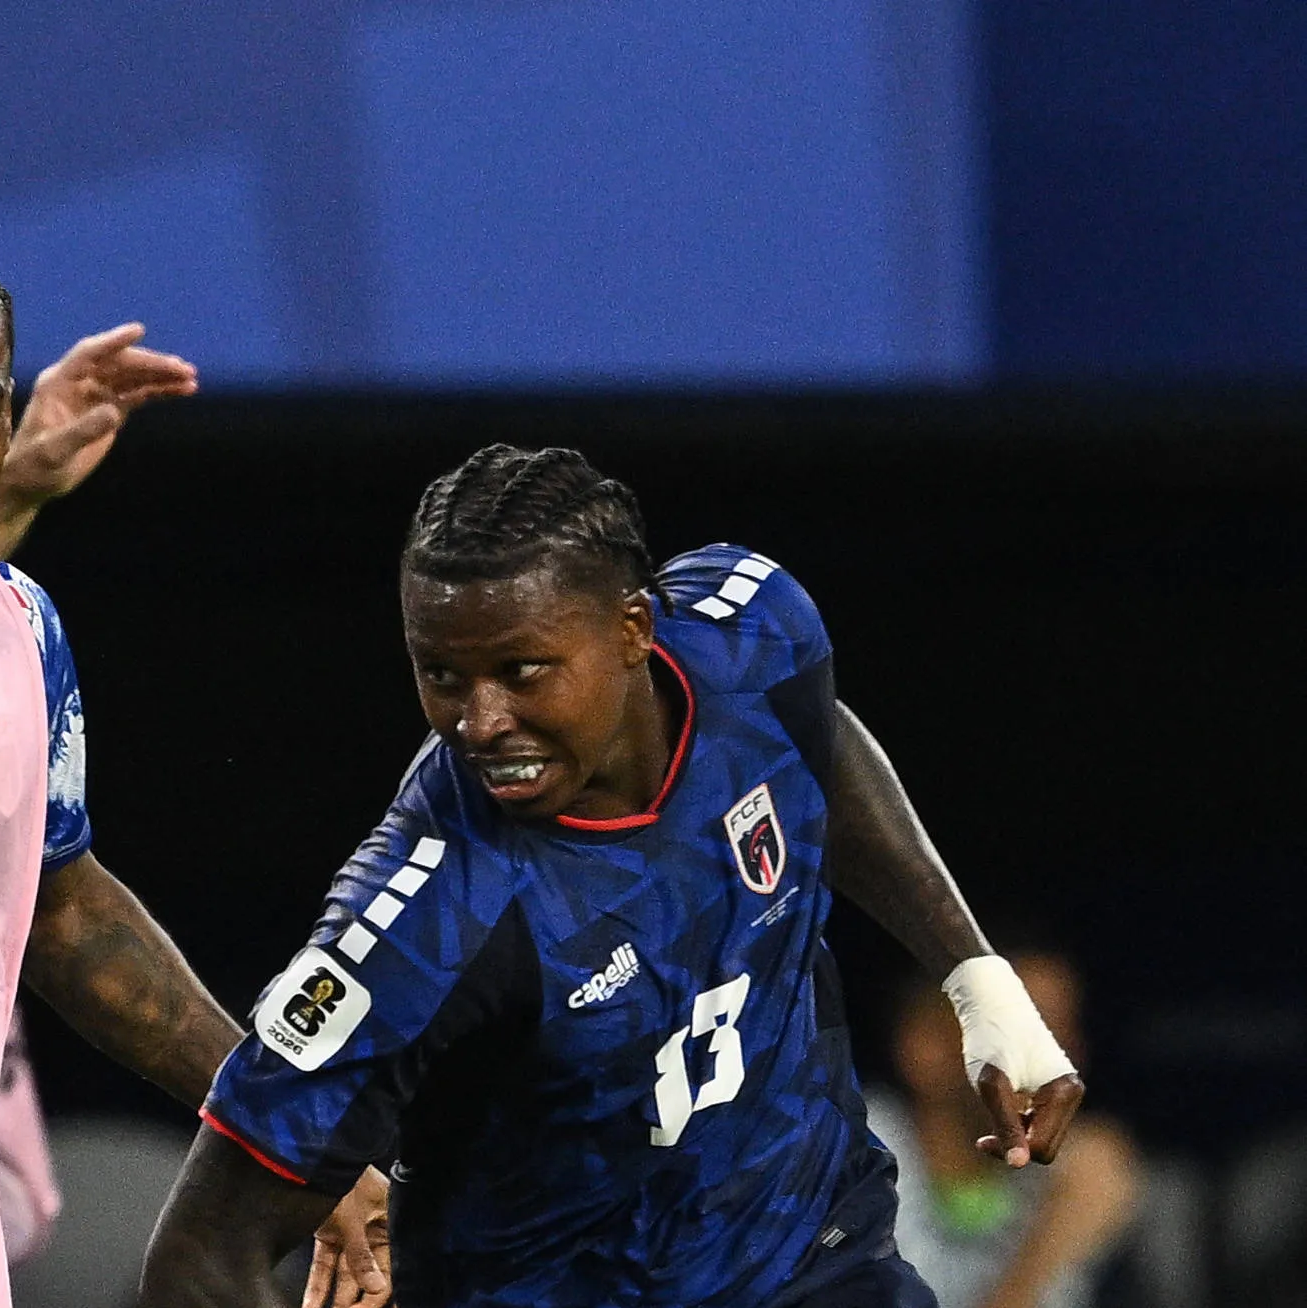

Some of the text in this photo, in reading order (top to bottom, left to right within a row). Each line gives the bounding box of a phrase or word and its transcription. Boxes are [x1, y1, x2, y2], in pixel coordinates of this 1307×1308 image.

[730, 792, 764, 832] FCF
[568, 942, 638, 1008] capelli
[266, 1025, 304, 1056] 2026
